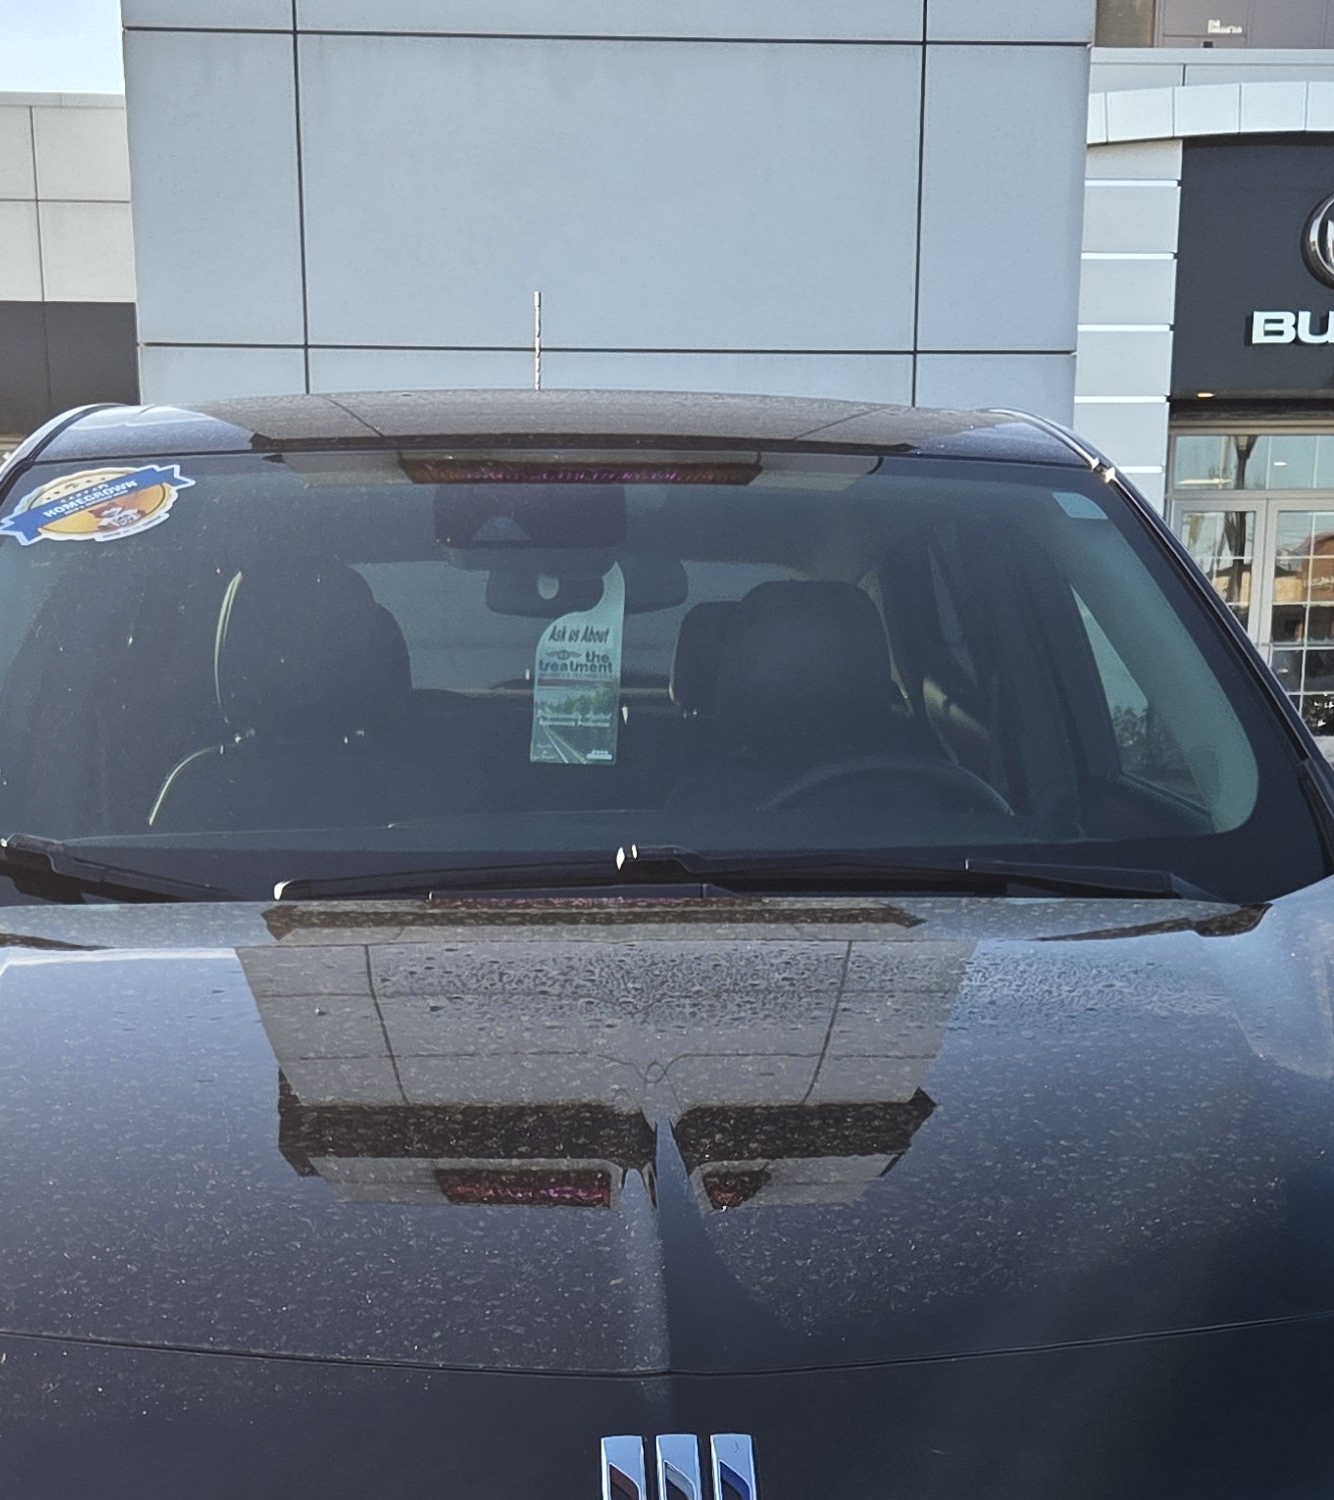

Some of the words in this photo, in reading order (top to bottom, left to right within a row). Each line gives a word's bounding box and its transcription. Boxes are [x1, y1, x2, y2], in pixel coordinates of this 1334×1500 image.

[43, 480, 138, 517] HOMEGROWN
[549, 625, 567, 642] Ask
[568, 629, 581, 643] us
[581, 625, 610, 643] About
[586, 650, 611, 664] the
[539, 659, 613, 673] treatment
